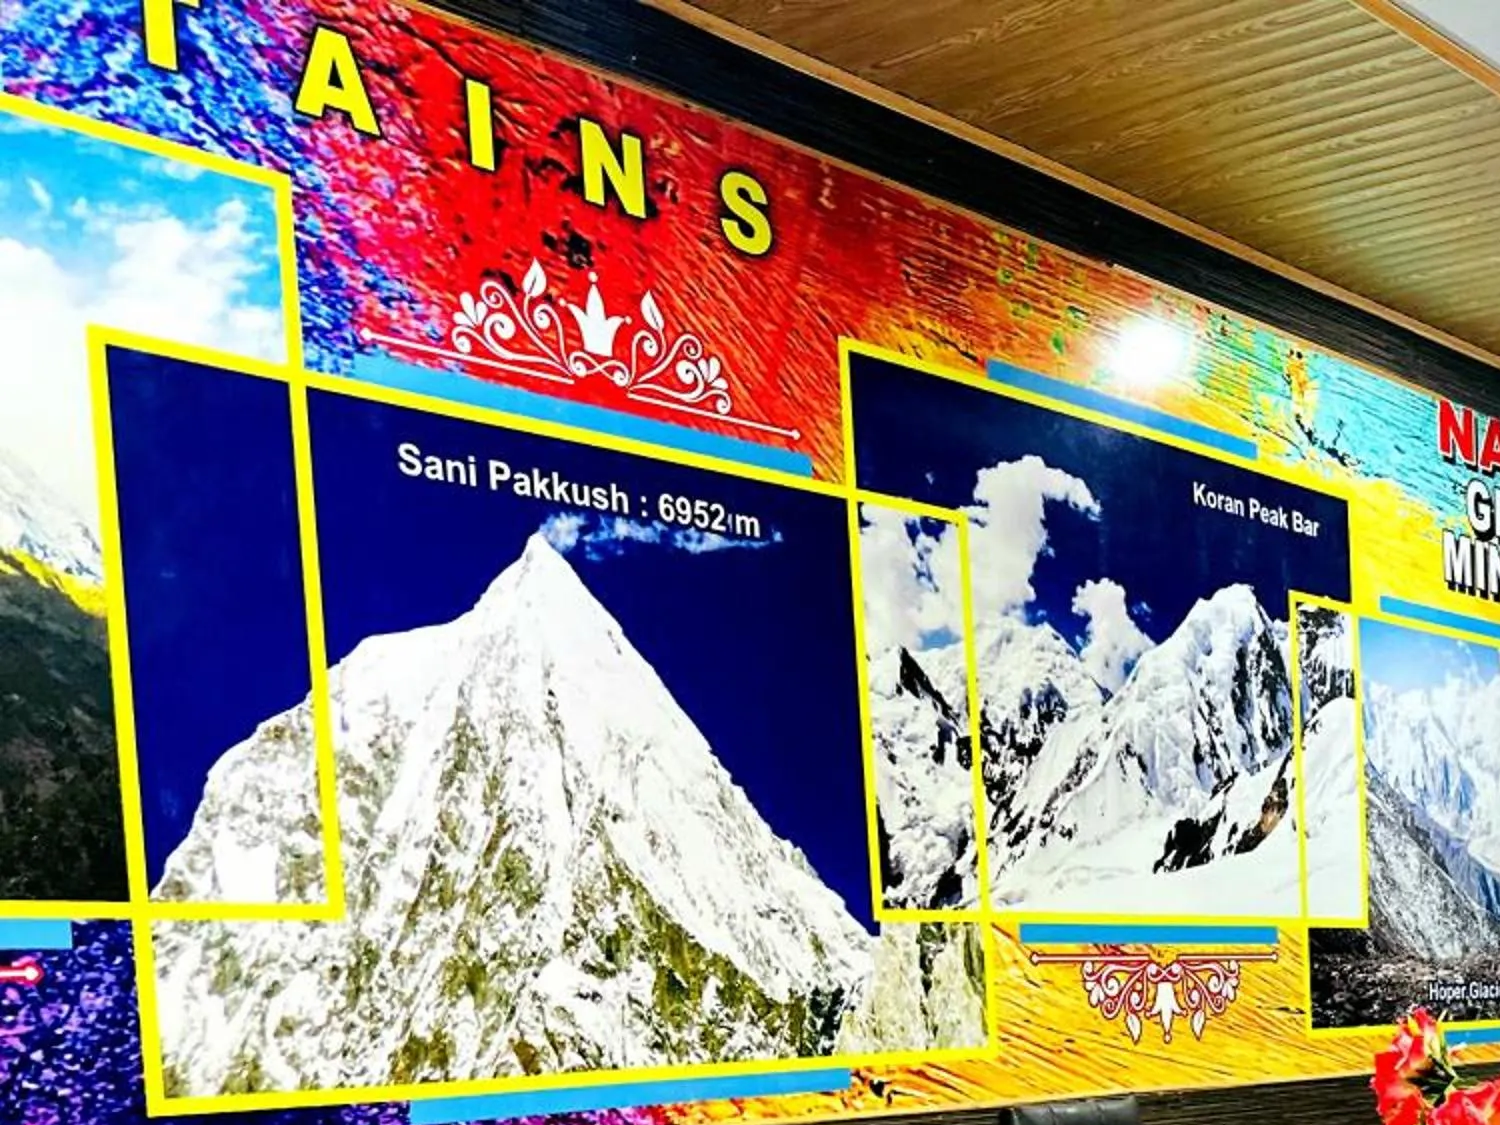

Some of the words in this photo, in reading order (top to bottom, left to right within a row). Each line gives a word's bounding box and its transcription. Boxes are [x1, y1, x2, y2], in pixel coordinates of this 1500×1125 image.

[398, 443, 477, 488] Sani
[488, 459, 629, 514] Pakkush
[1193, 481, 1245, 517] Koran
[1249, 497, 1288, 530] Peak
[1292, 510, 1319, 537] Bar
